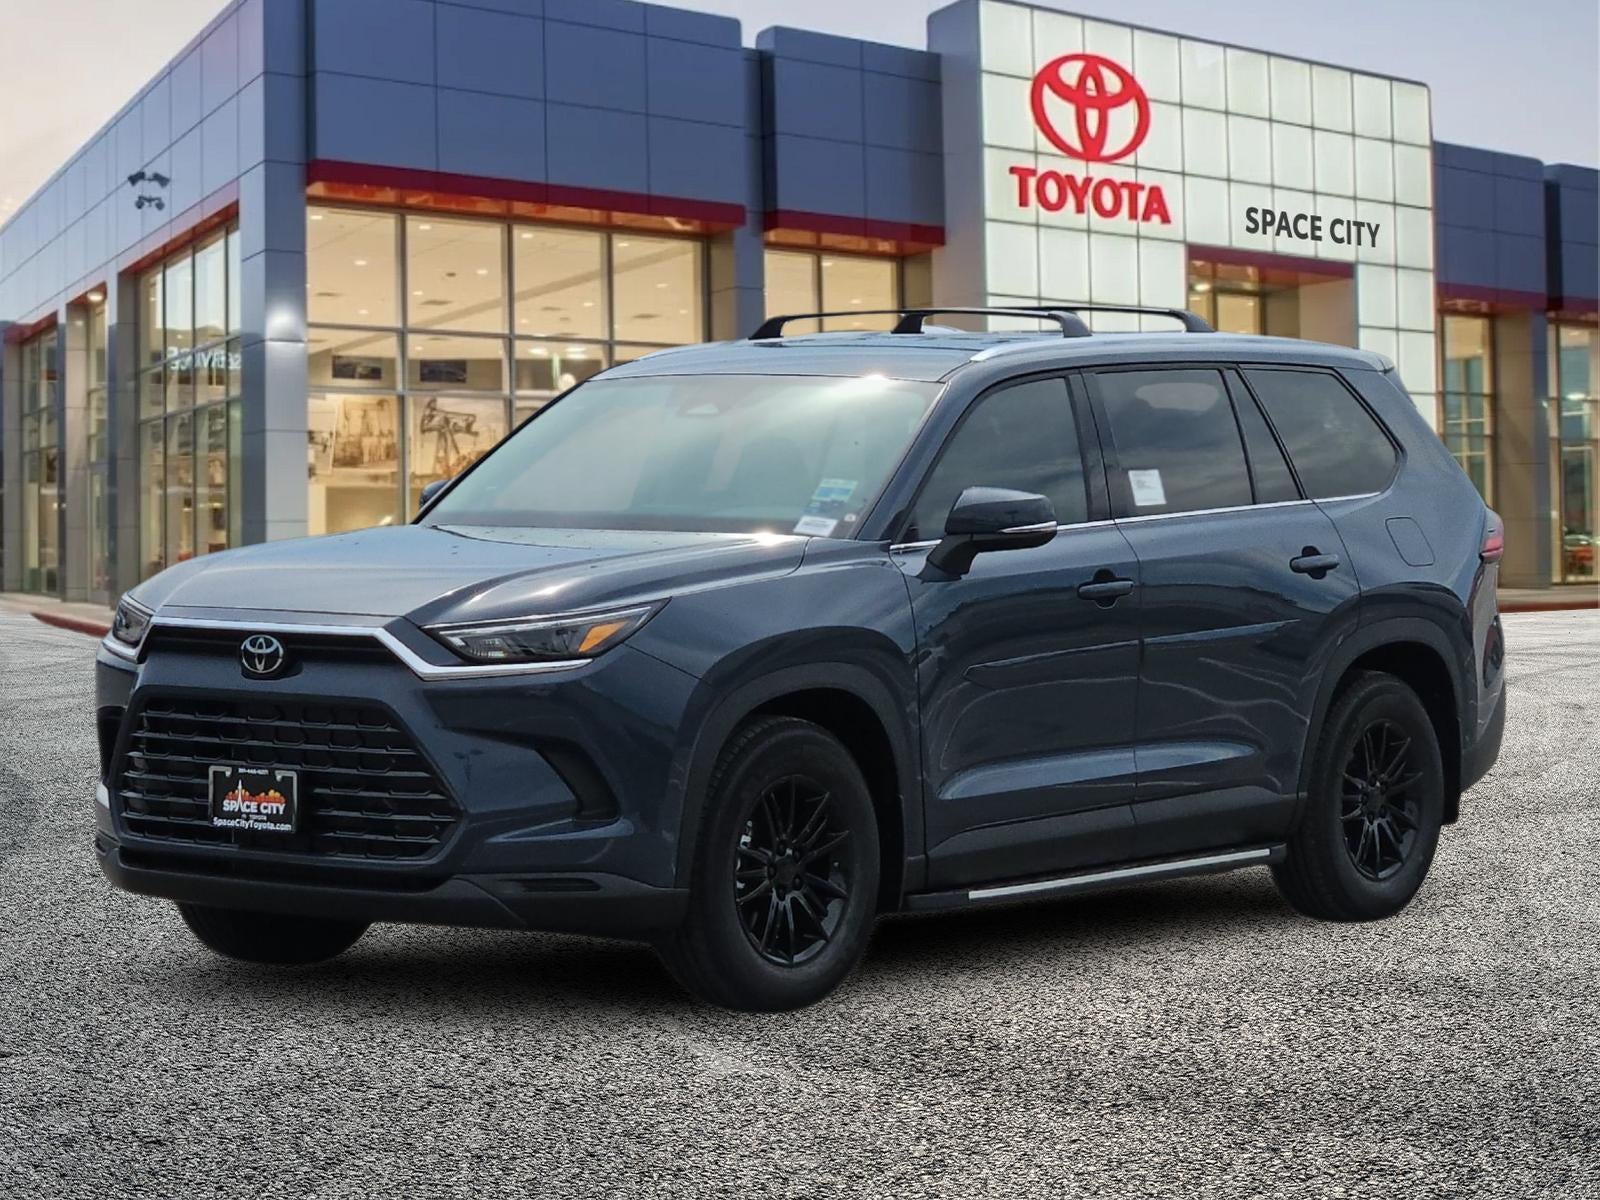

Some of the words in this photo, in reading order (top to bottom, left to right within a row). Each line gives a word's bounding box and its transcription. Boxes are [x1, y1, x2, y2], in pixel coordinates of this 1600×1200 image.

[1009, 167, 1171, 224] TOYOTA
[1245, 207, 1322, 242] SPACE
[1329, 218, 1380, 248] CITY
[223, 798, 258, 813] SPACE
[260, 802, 286, 814] CITY
[213, 816, 292, 831] SpaceCityToyota.com
